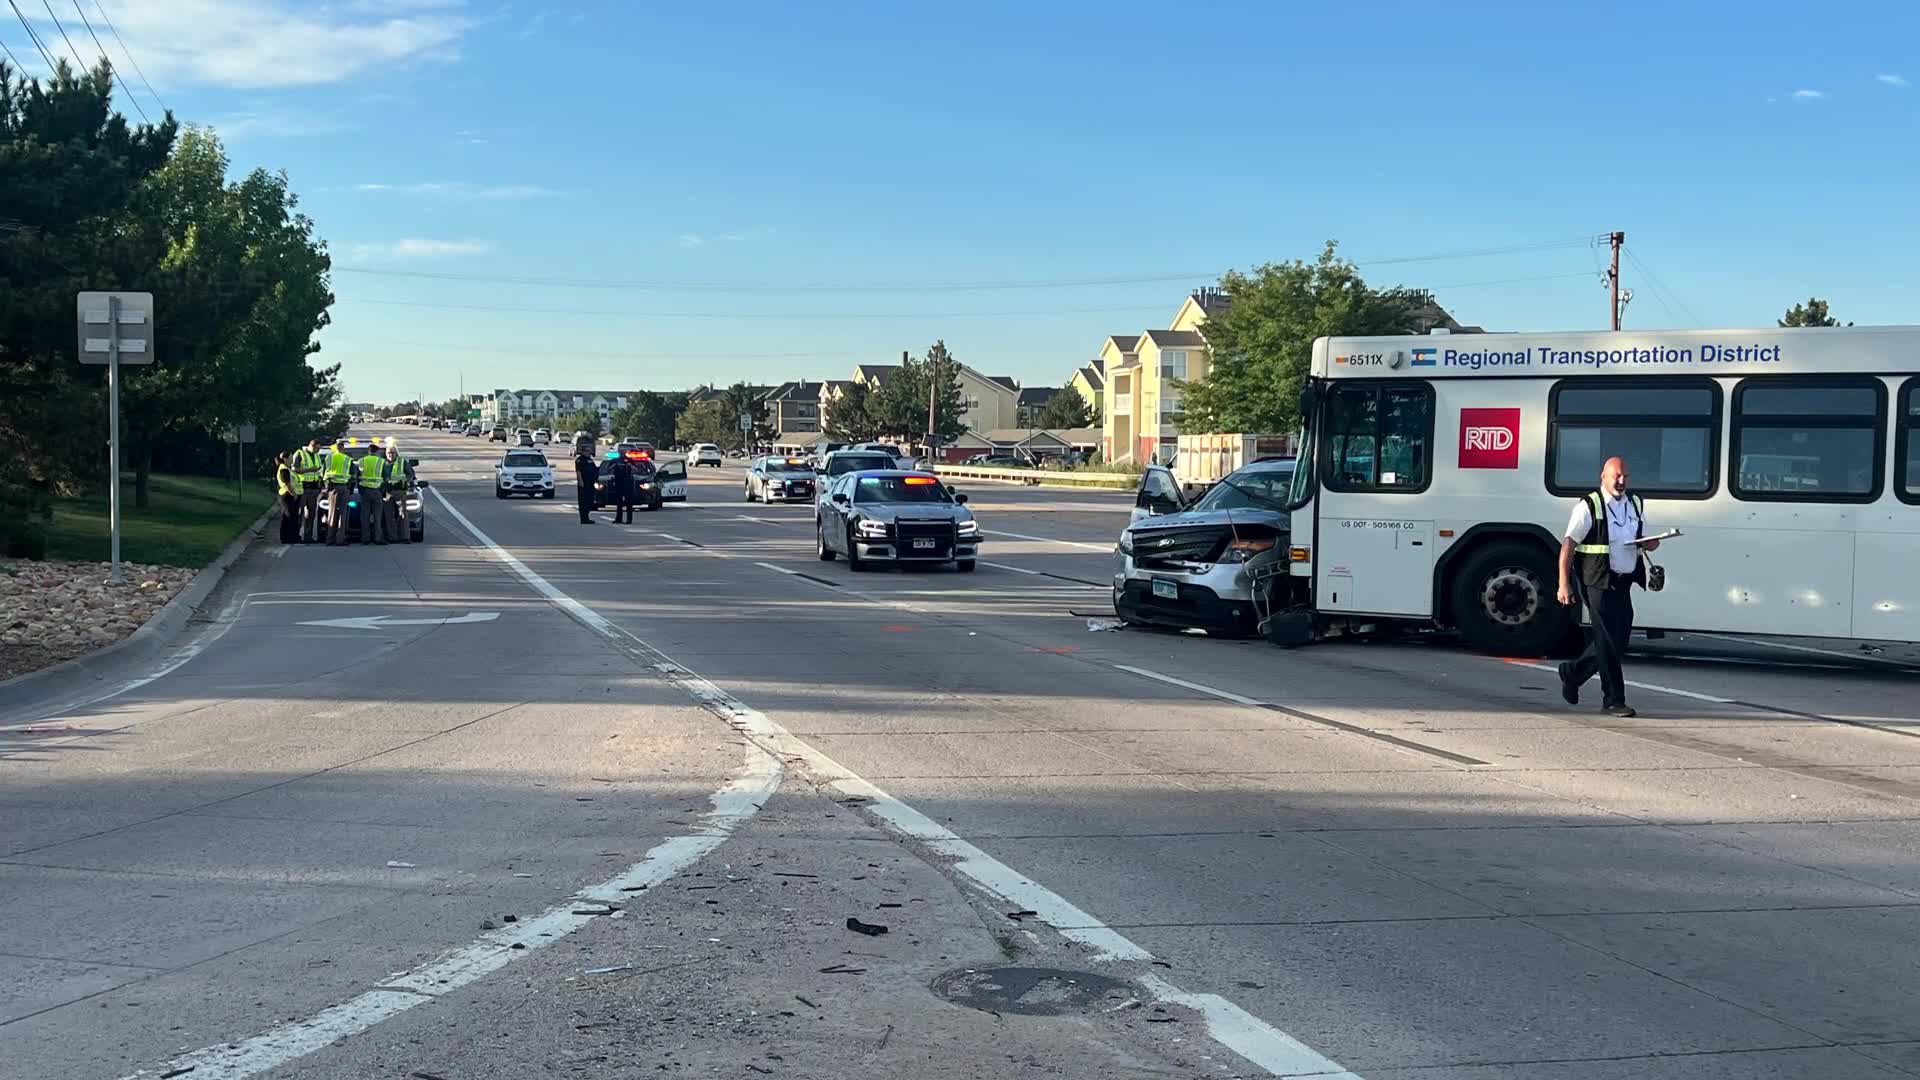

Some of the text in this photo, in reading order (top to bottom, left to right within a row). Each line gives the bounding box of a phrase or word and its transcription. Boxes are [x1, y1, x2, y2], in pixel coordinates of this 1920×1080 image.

[1349, 354, 1383, 366] 6511X
[1444, 344, 1781, 370] Regional Transportation District
[1465, 426, 1513, 450] RTD
[1341, 521, 1351, 529] US
[1403, 522, 1414, 530] CO
